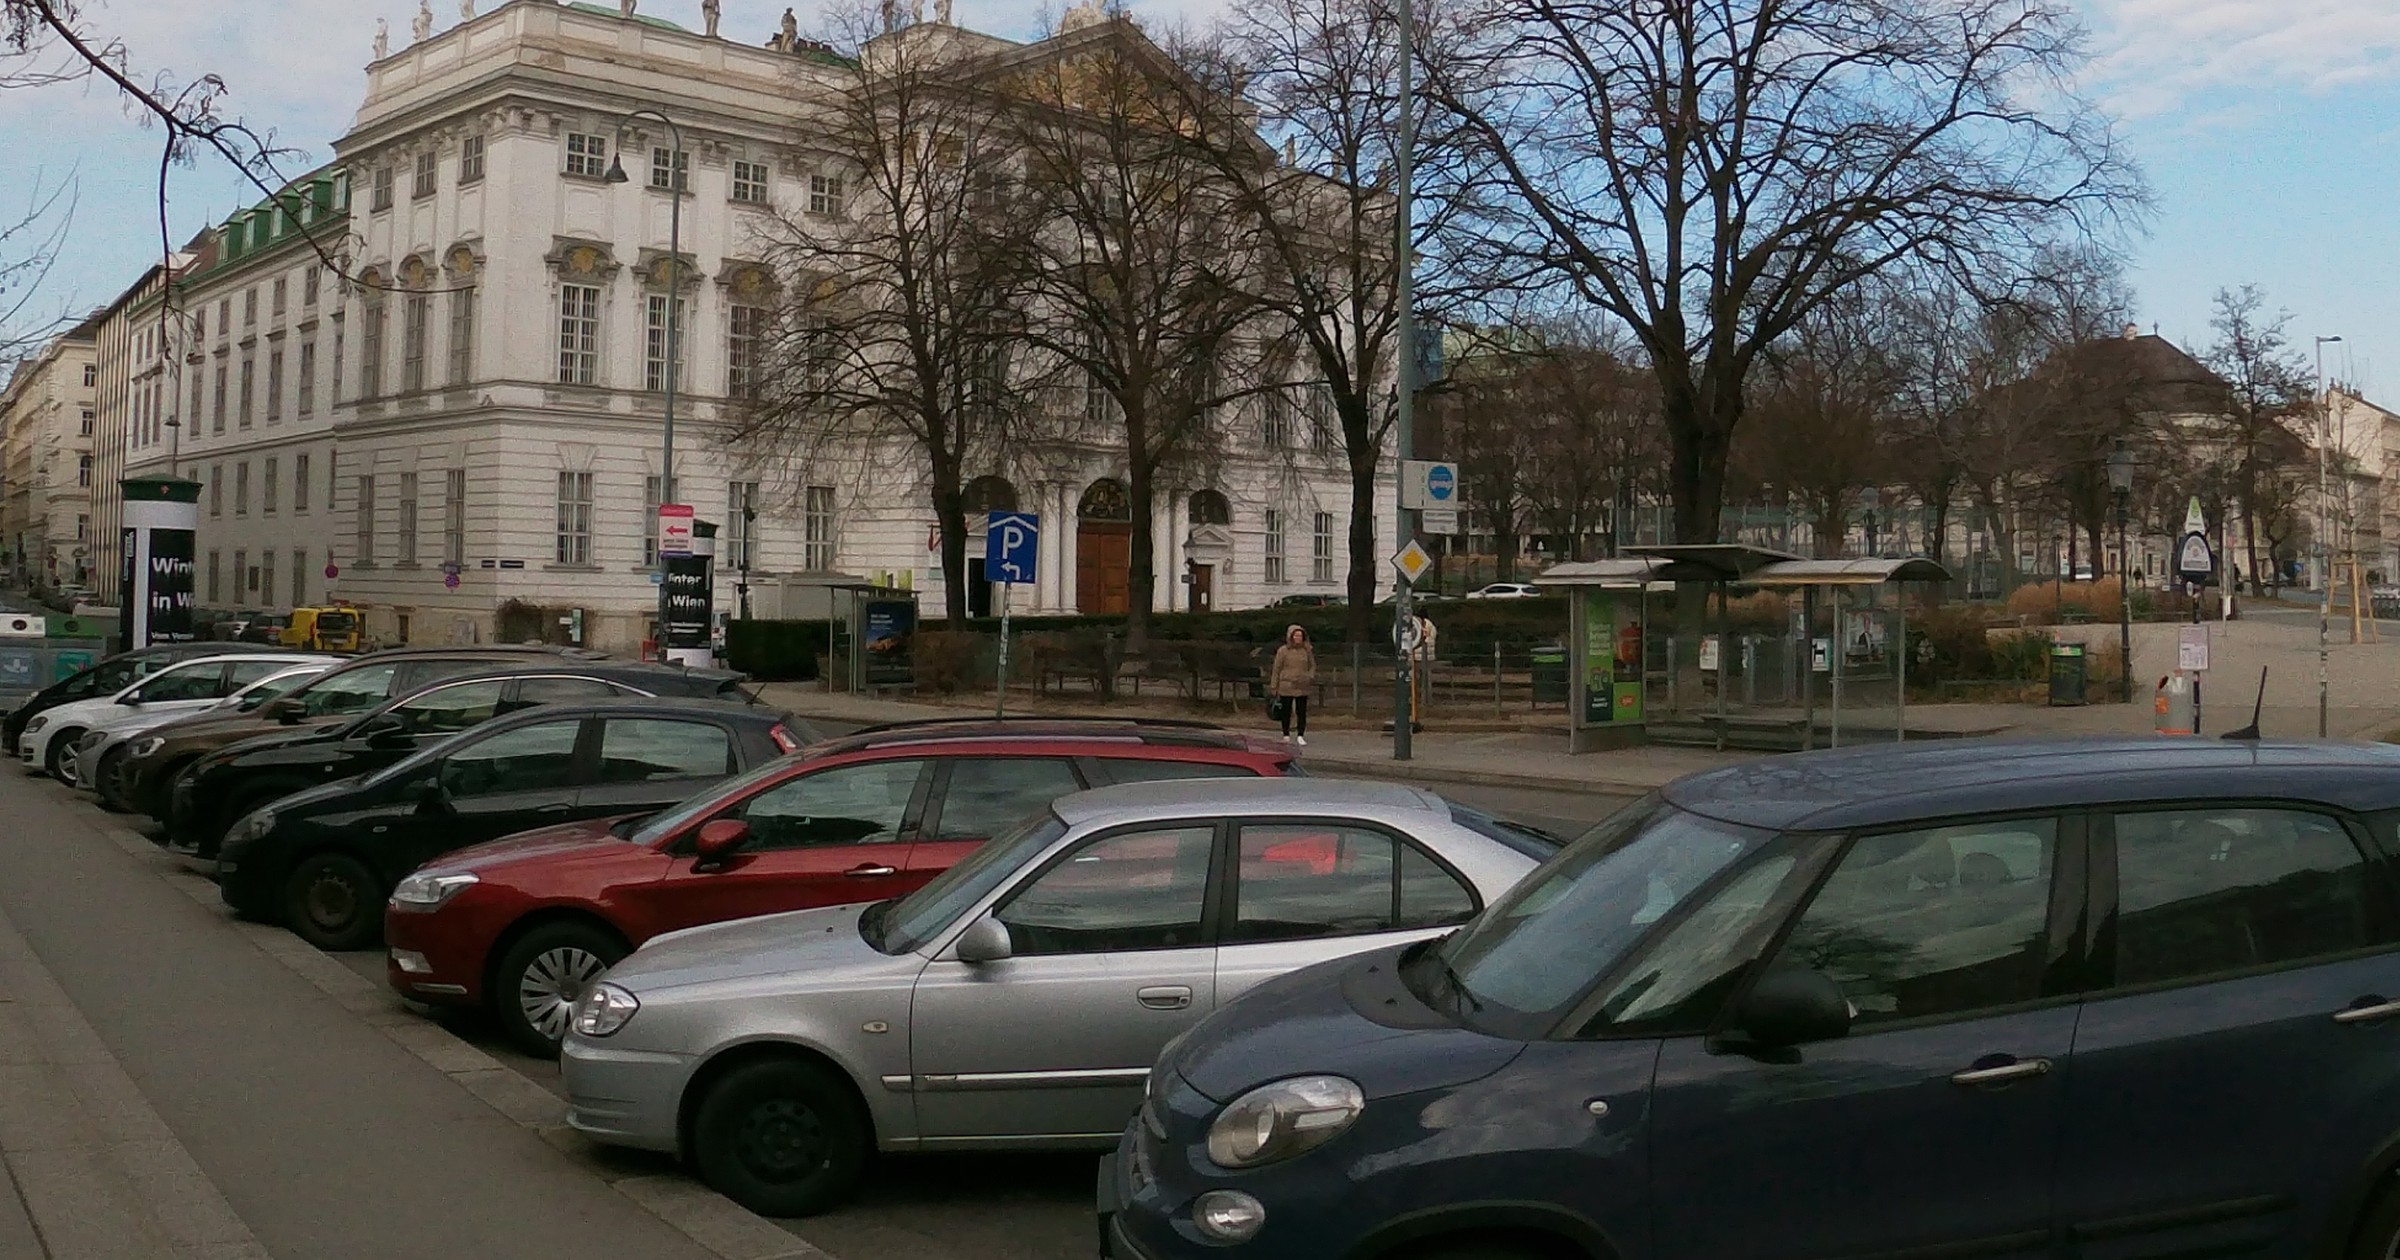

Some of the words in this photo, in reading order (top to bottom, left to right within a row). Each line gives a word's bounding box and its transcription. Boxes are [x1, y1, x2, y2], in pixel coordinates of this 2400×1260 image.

[1002, 526, 1024, 560] P
[152, 591, 171, 611] in
[672, 595, 706, 607] Wien
